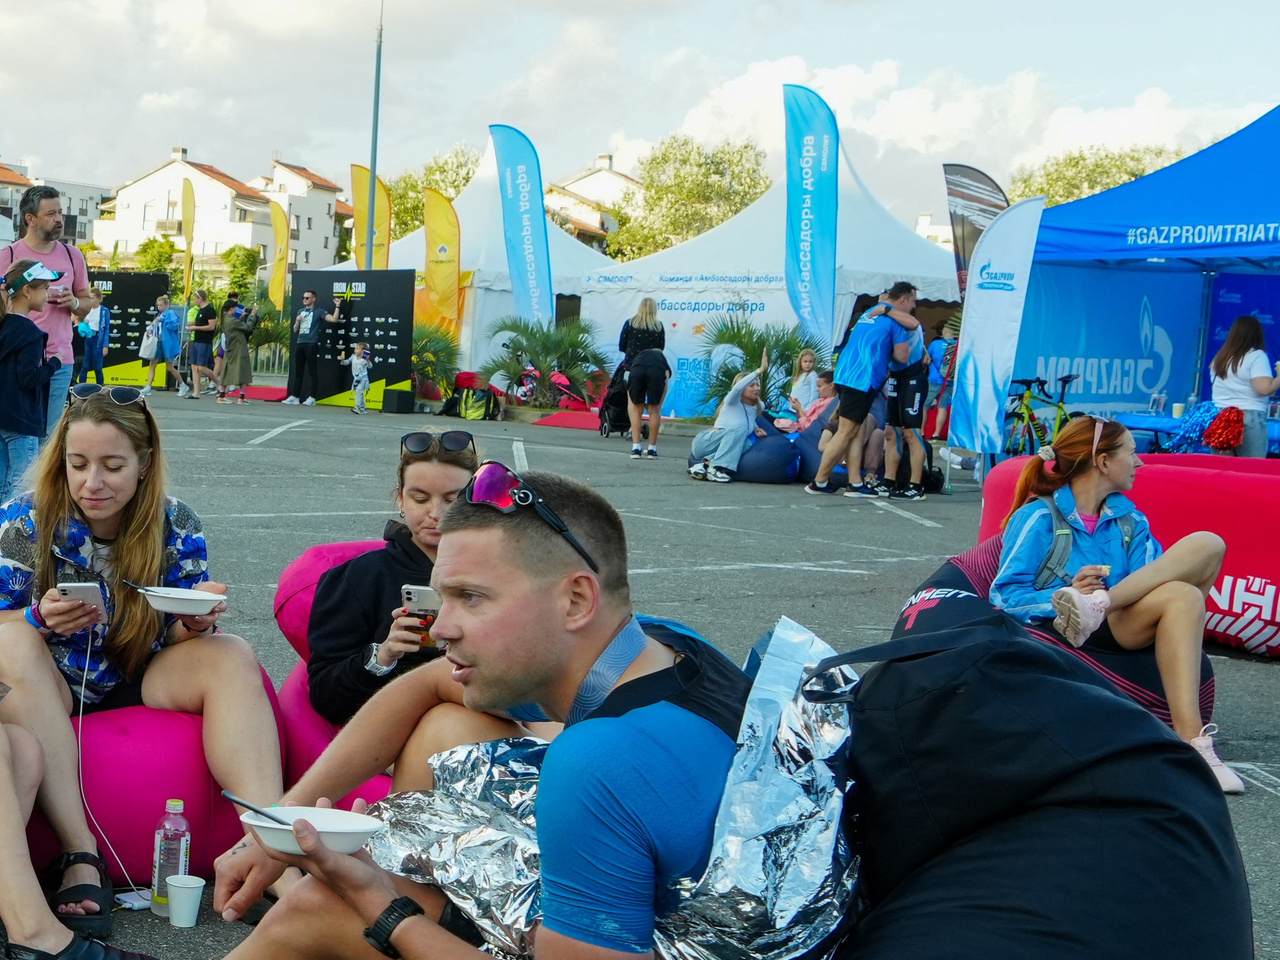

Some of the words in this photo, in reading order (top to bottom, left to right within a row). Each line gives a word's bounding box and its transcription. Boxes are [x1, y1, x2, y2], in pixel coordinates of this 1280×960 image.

[800, 135, 815, 191] добра
[799, 194, 814, 320] Амбассадоры
[659, 274, 693, 283] Команда
[333, 282, 347, 293] IRON
[351, 282, 367, 293] STAR
[656, 299, 725, 313] бассадоры
[727, 299, 765, 315] добра
